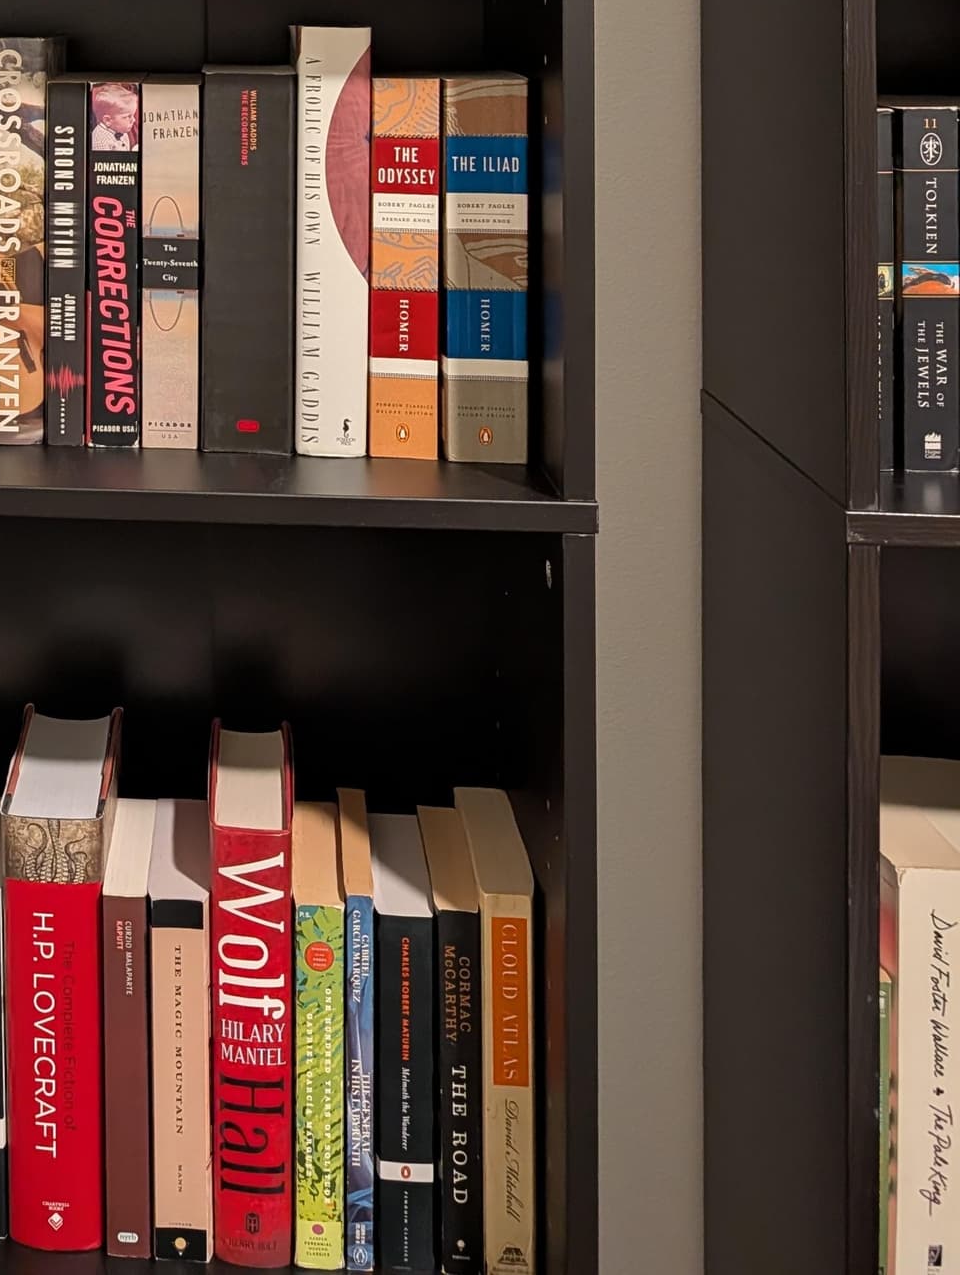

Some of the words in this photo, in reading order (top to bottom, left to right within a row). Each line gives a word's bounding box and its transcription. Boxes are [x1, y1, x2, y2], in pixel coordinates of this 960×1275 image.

[54, 125, 75, 192] STRONG
[93, 162, 138, 173] JONATHAN
[96, 175, 135, 186] FRANZEN
[377, 167, 436, 185] ODYSSEY
[393, 146, 418, 163] THE
[451, 156, 478, 172] THE
[482, 155, 519, 172] ILIAD
[54, 201, 75, 269] MOTION
[925, 177, 938, 255] TOLKIEN
[143, 259, 199, 268] Twenty-Seventh
[162, 244, 177, 252] The
[92, 196, 135, 416] CORRECTIONS
[162, 273, 178, 283] City
[302, 271, 321, 359] WILLIAM
[398, 298, 409, 352] HOMER
[301, 370, 319, 445] GADDIS
[32, 911, 55, 963] H.P.
[216, 851, 286, 1020] Wolf
[501, 923, 518, 1001] CLOUD
[930, 908, 958, 966] David
[459, 956, 471, 1033] CORMAC
[931, 965, 951, 1017] Foster
[220, 1019, 286, 1044] HILARY
[220, 1043, 286, 1066] MANTEL
[501, 1014, 518, 1081] ATLAS
[932, 1020, 950, 1078] Wallace
[33, 973, 58, 1159] LOVECRAFT
[451, 1065, 467, 1117] THE
[219, 1074, 285, 1197] Hall
[452, 1131, 468, 1205] ROAD
